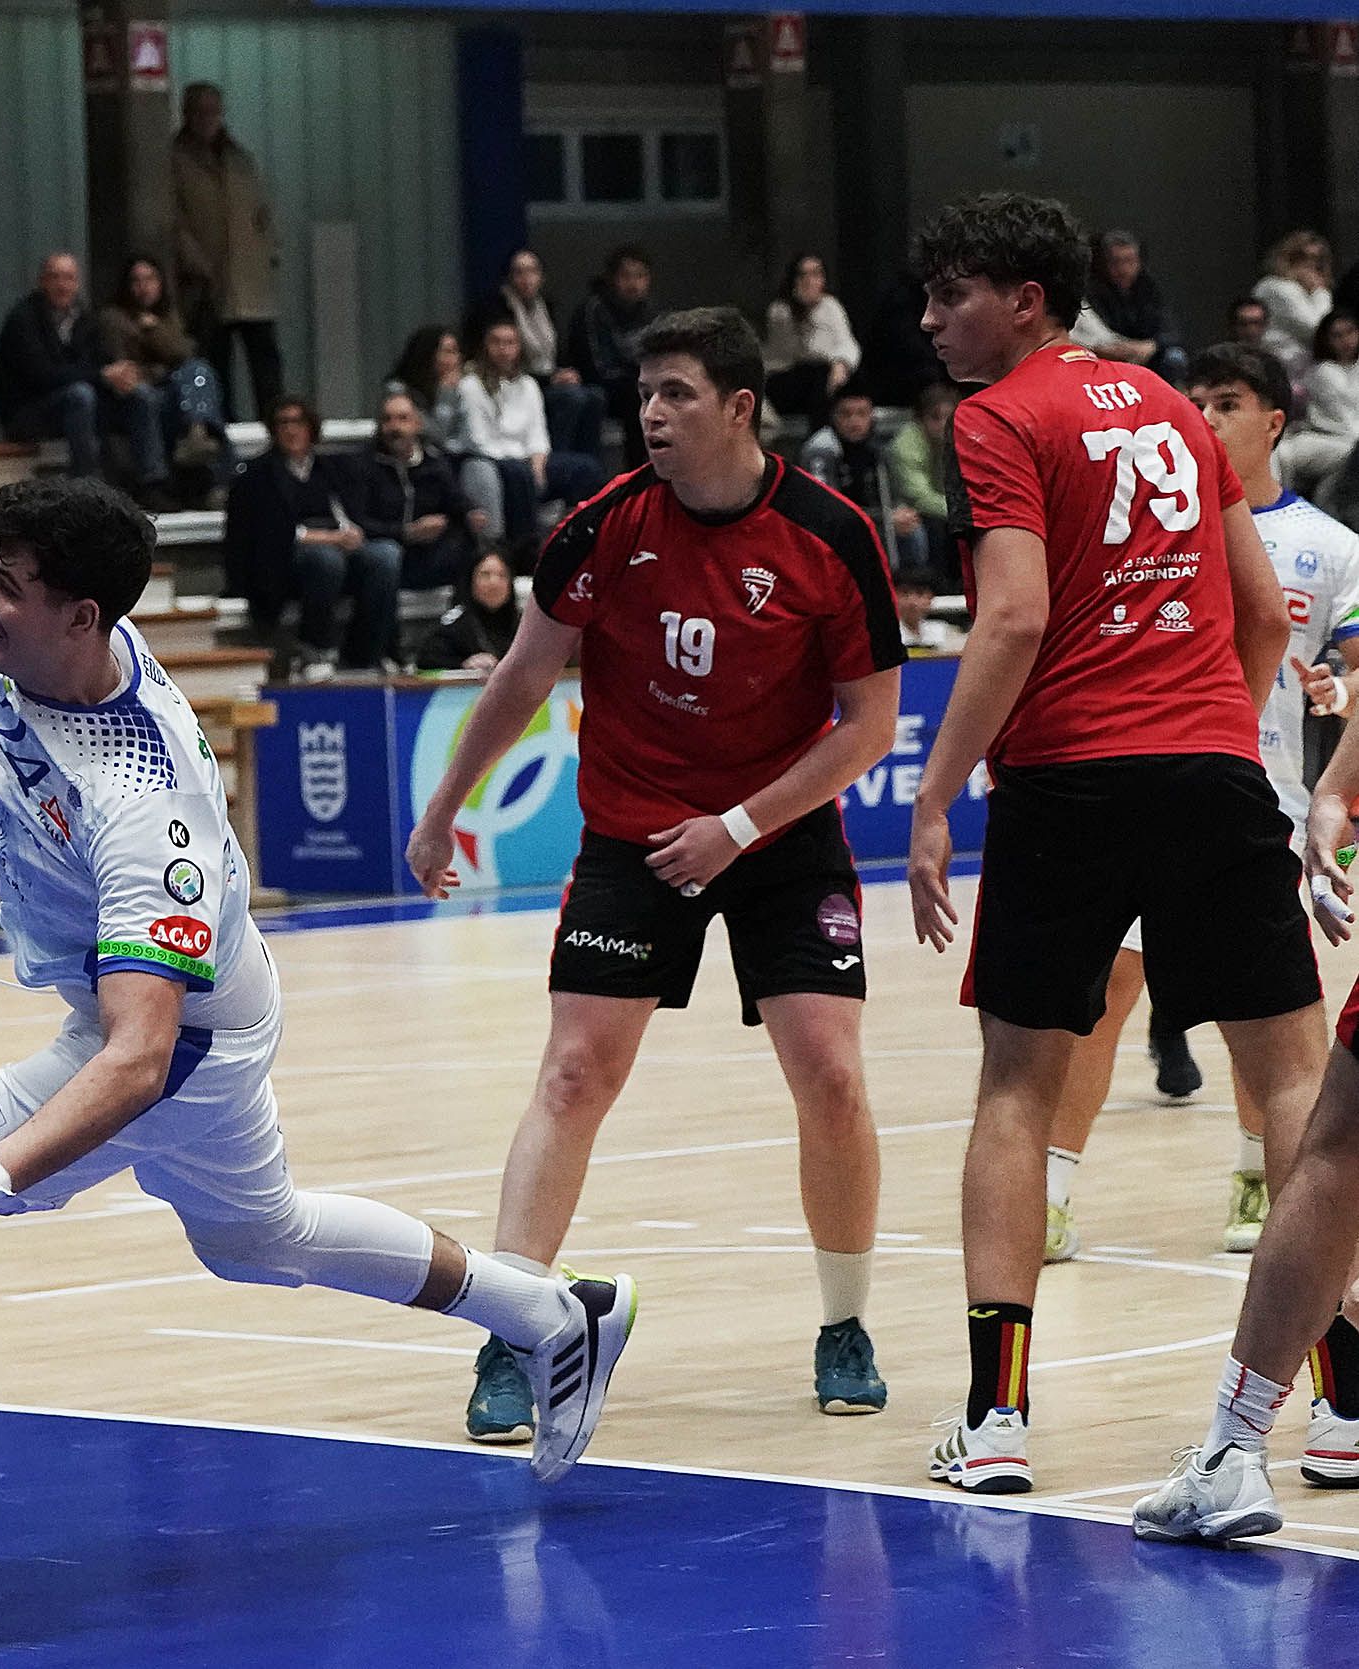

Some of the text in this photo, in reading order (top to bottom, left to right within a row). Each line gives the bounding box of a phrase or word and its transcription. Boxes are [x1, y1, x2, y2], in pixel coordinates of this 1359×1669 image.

[1082, 381, 1142, 410] LITA
[1081, 421, 1201, 545] 79
[659, 611, 716, 677] 19
[152, 924, 208, 951] AC&C
